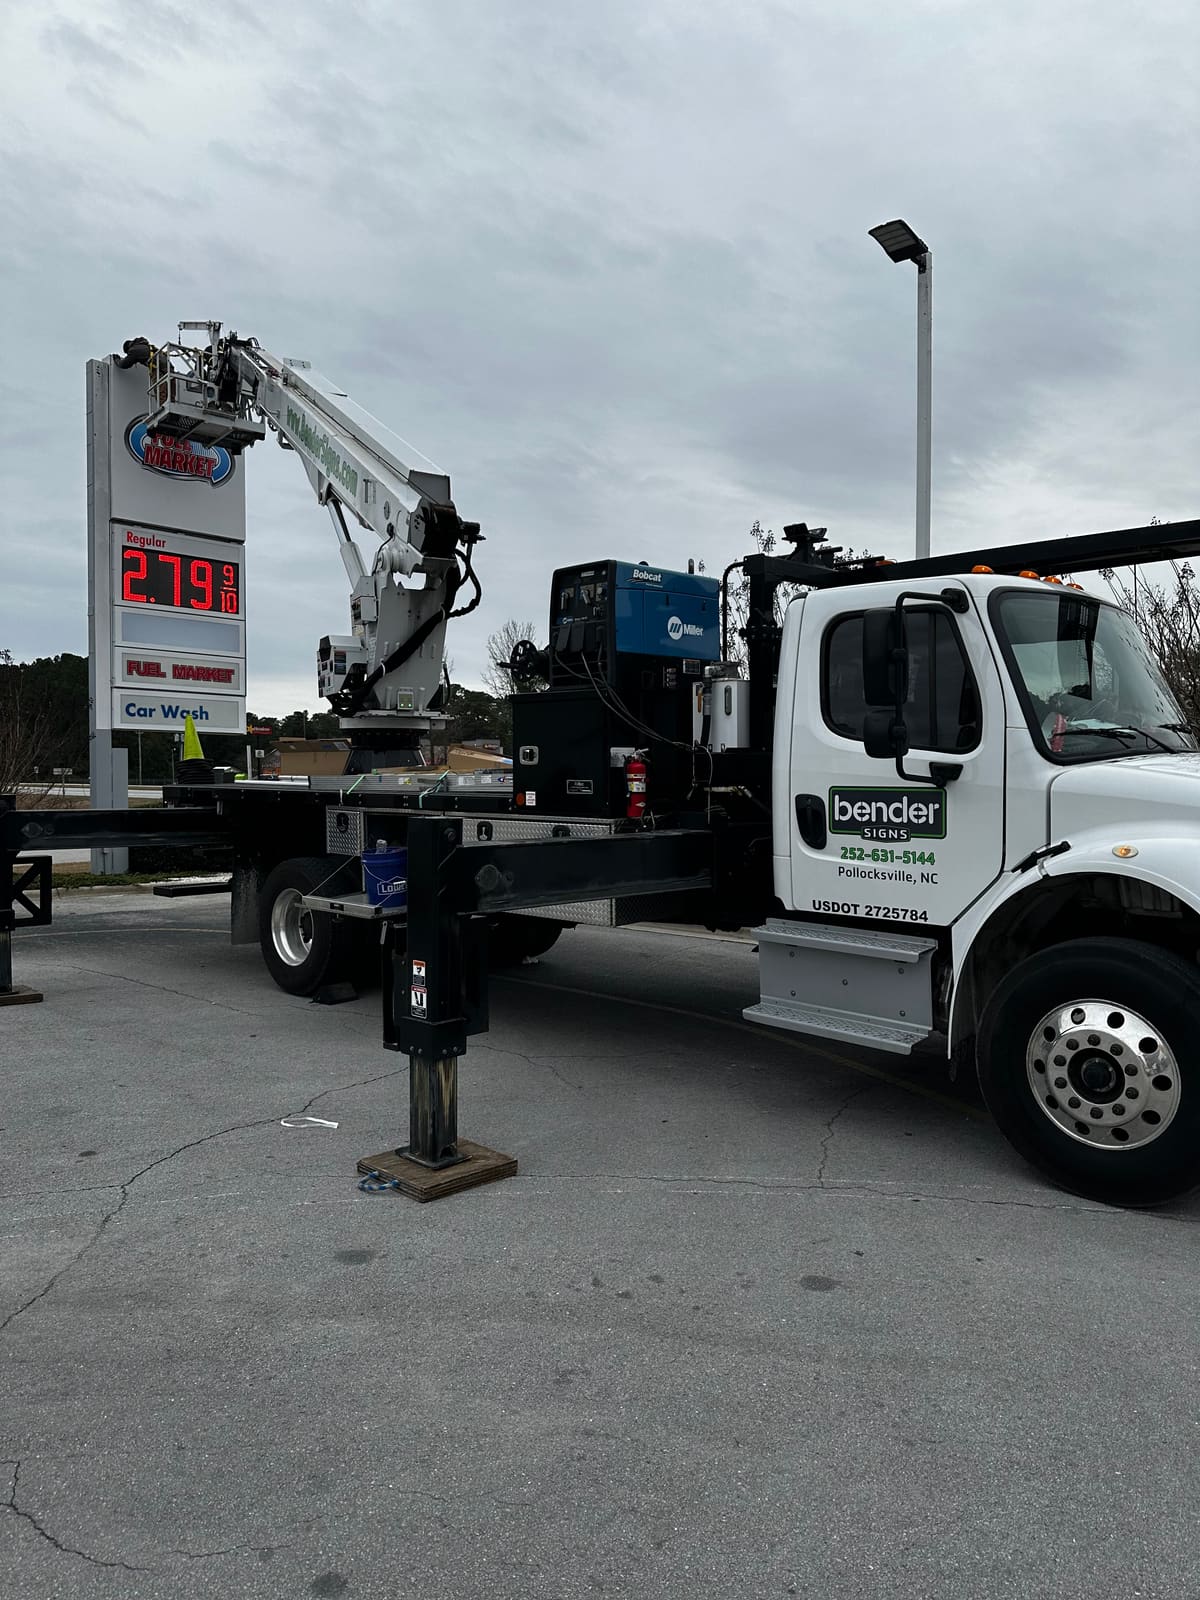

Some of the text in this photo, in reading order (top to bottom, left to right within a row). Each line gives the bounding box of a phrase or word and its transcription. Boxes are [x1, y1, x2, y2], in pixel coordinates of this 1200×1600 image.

[143, 444, 217, 478] MARKET
[126, 531, 167, 548] Regular
[123, 549, 213, 610] 2.79
[632, 569, 662, 582] Bobcat
[126, 659, 236, 684] FUEL MARKET
[125, 702, 210, 721] Car Wash
[834, 795, 940, 824] bender
[863, 828, 908, 840] SIGNS
[840, 846, 936, 866] 252-631-5144
[838, 866, 939, 885] Pollocksville, NC
[812, 899, 928, 922] USDOT 2725784
